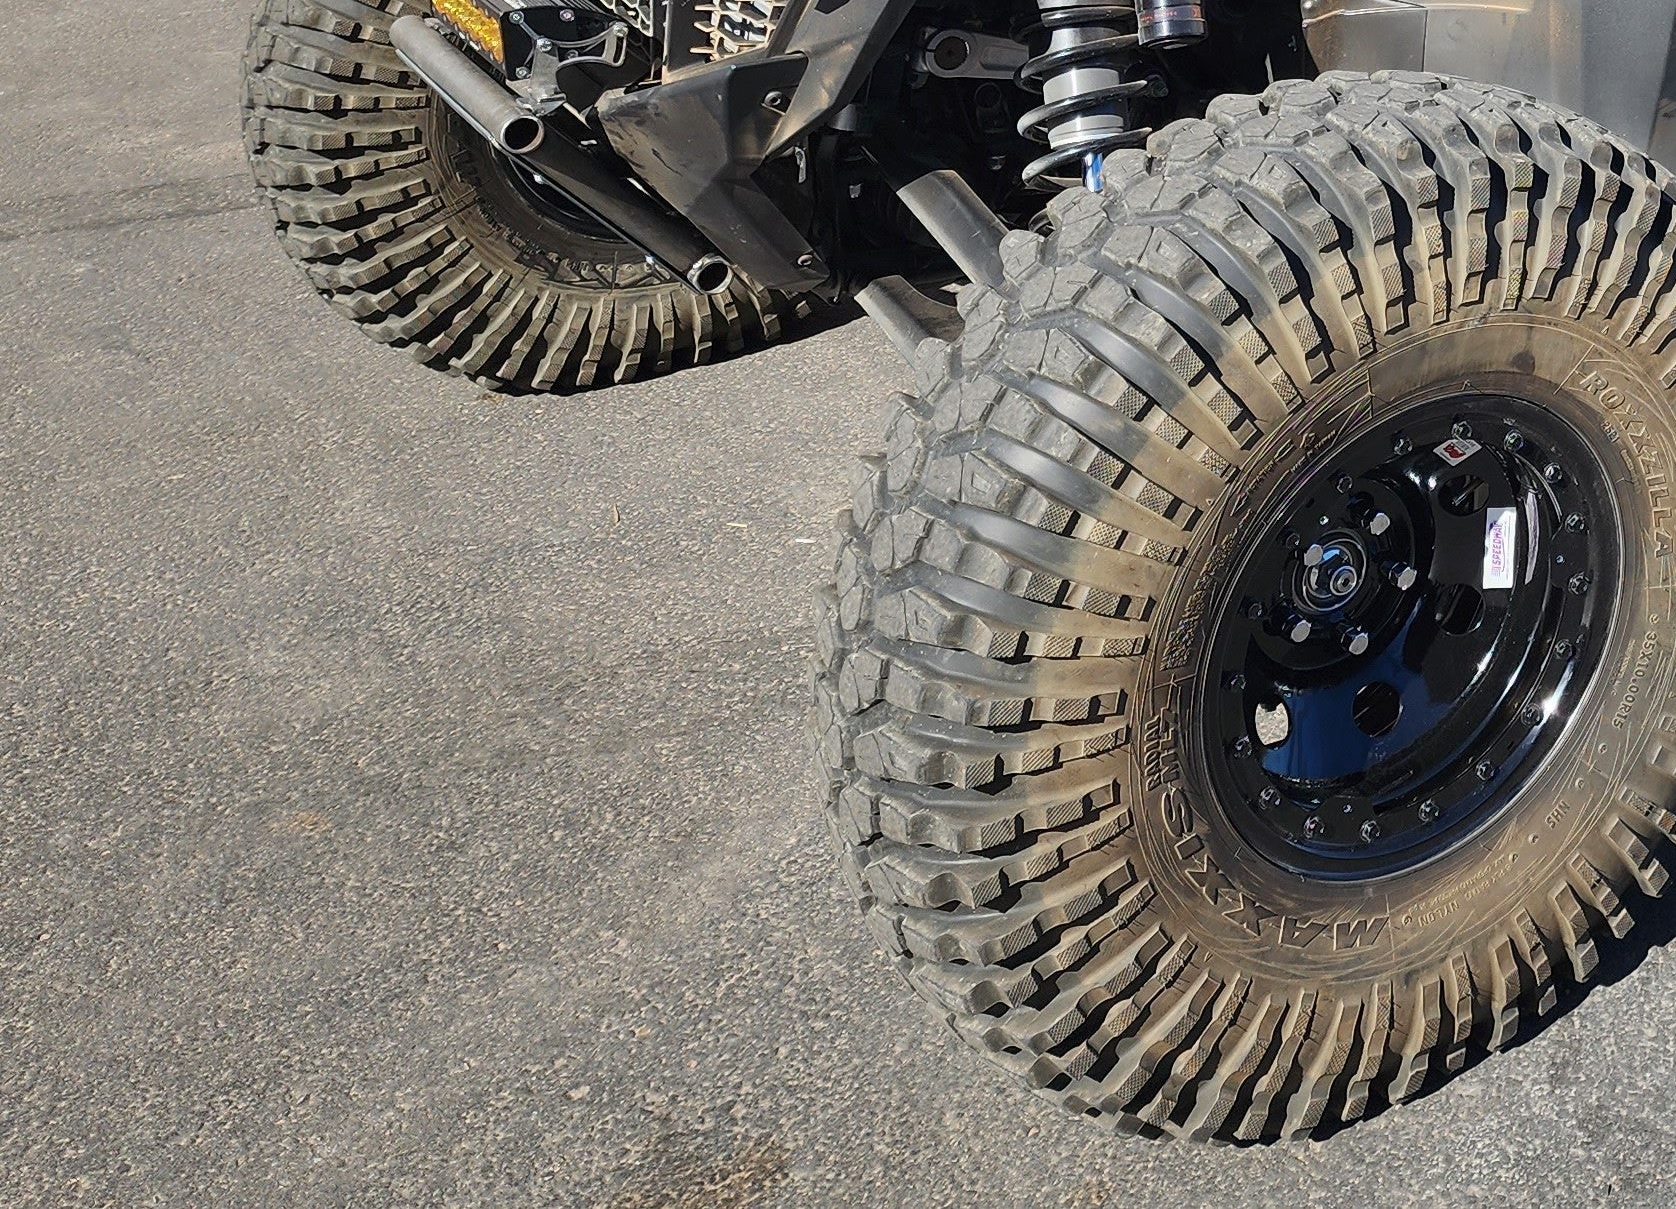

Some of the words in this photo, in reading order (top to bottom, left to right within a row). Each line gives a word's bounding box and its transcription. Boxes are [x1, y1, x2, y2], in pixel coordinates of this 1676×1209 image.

[1579, 370, 1675, 559] ROXXZILLA
[1491, 521, 1504, 567] SPEEDWAY
[1611, 630, 1660, 730] 35X10.00R15
[1144, 714, 1162, 791] RADIAL
[1543, 800, 1571, 829] NHS
[1161, 787, 1390, 951] MAXXIS
